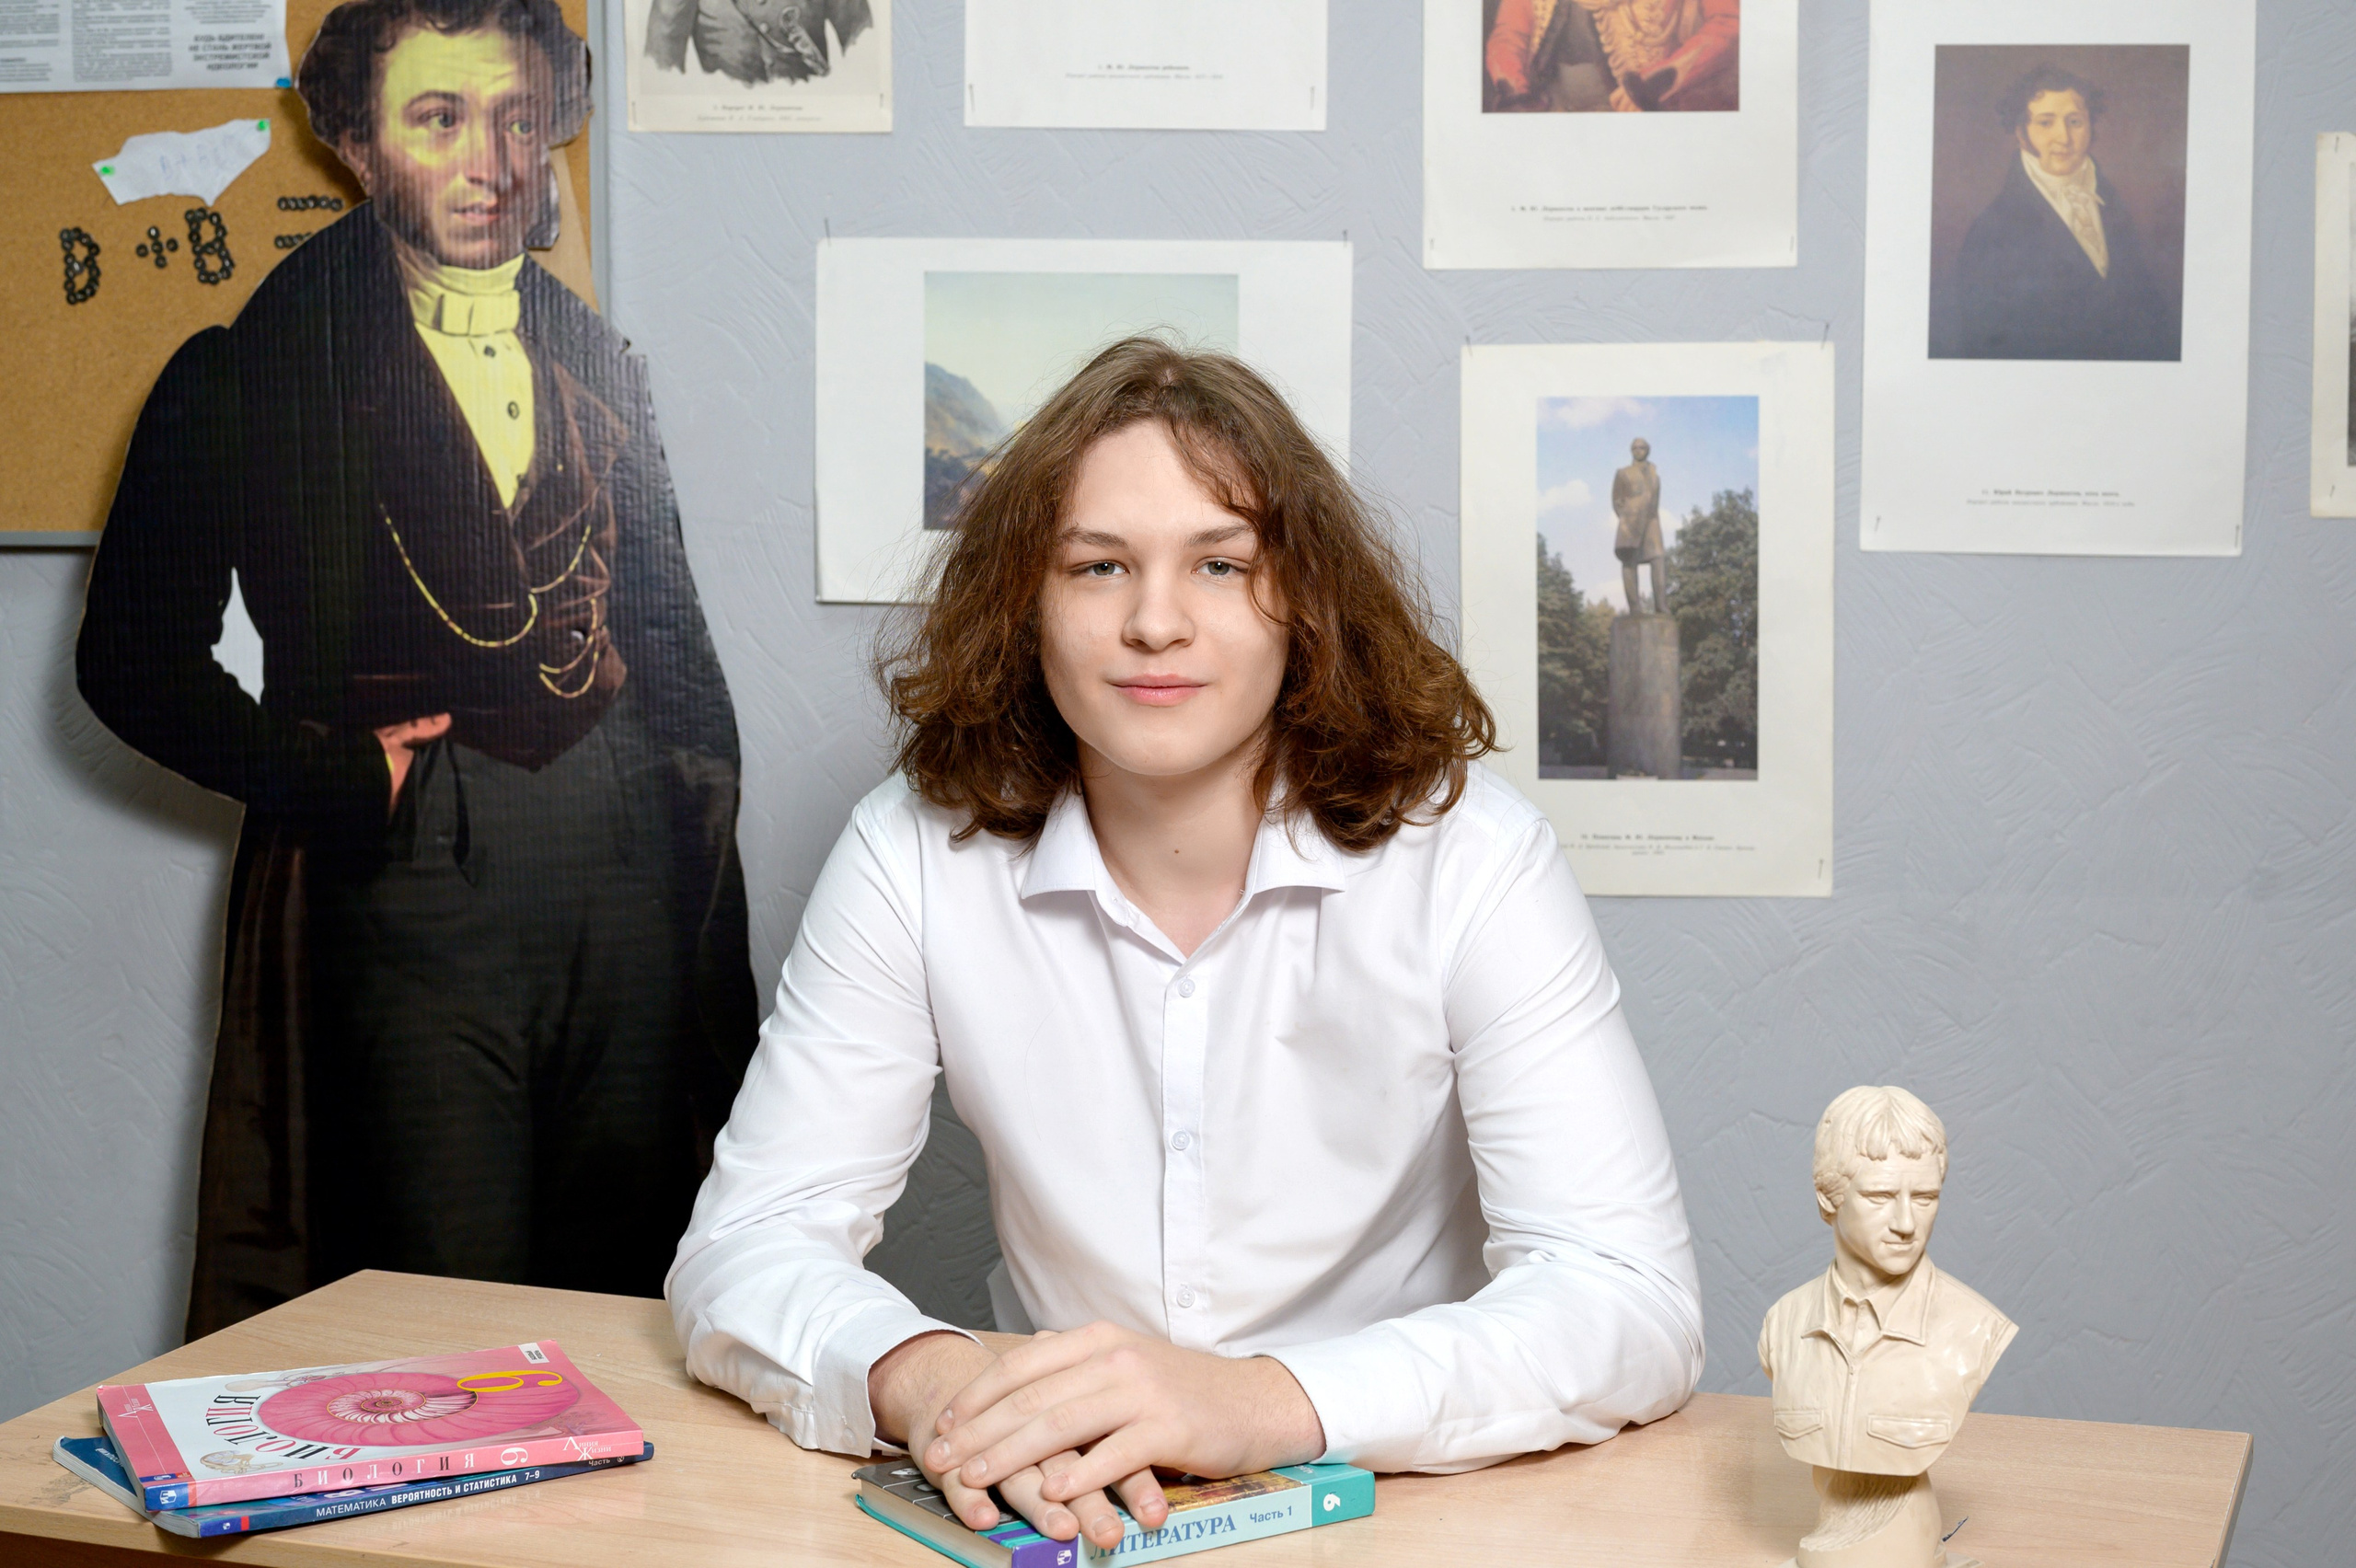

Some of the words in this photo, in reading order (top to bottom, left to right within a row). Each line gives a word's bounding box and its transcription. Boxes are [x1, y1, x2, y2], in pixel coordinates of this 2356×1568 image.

[294, 1452, 475, 1488] БИОЛОГИЯ
[589, 1458, 611, 1466] Часть
[316, 1497, 387, 1517] МАТЕМАТИКА
[391, 1481, 453, 1505] ВЕРОЯТНОСТЬ
[455, 1481, 461, 1493] И
[463, 1473, 517, 1493] СТАТИСТИКА
[1249, 1510, 1284, 1524] Часть
[1287, 1505, 1292, 1516] 1
